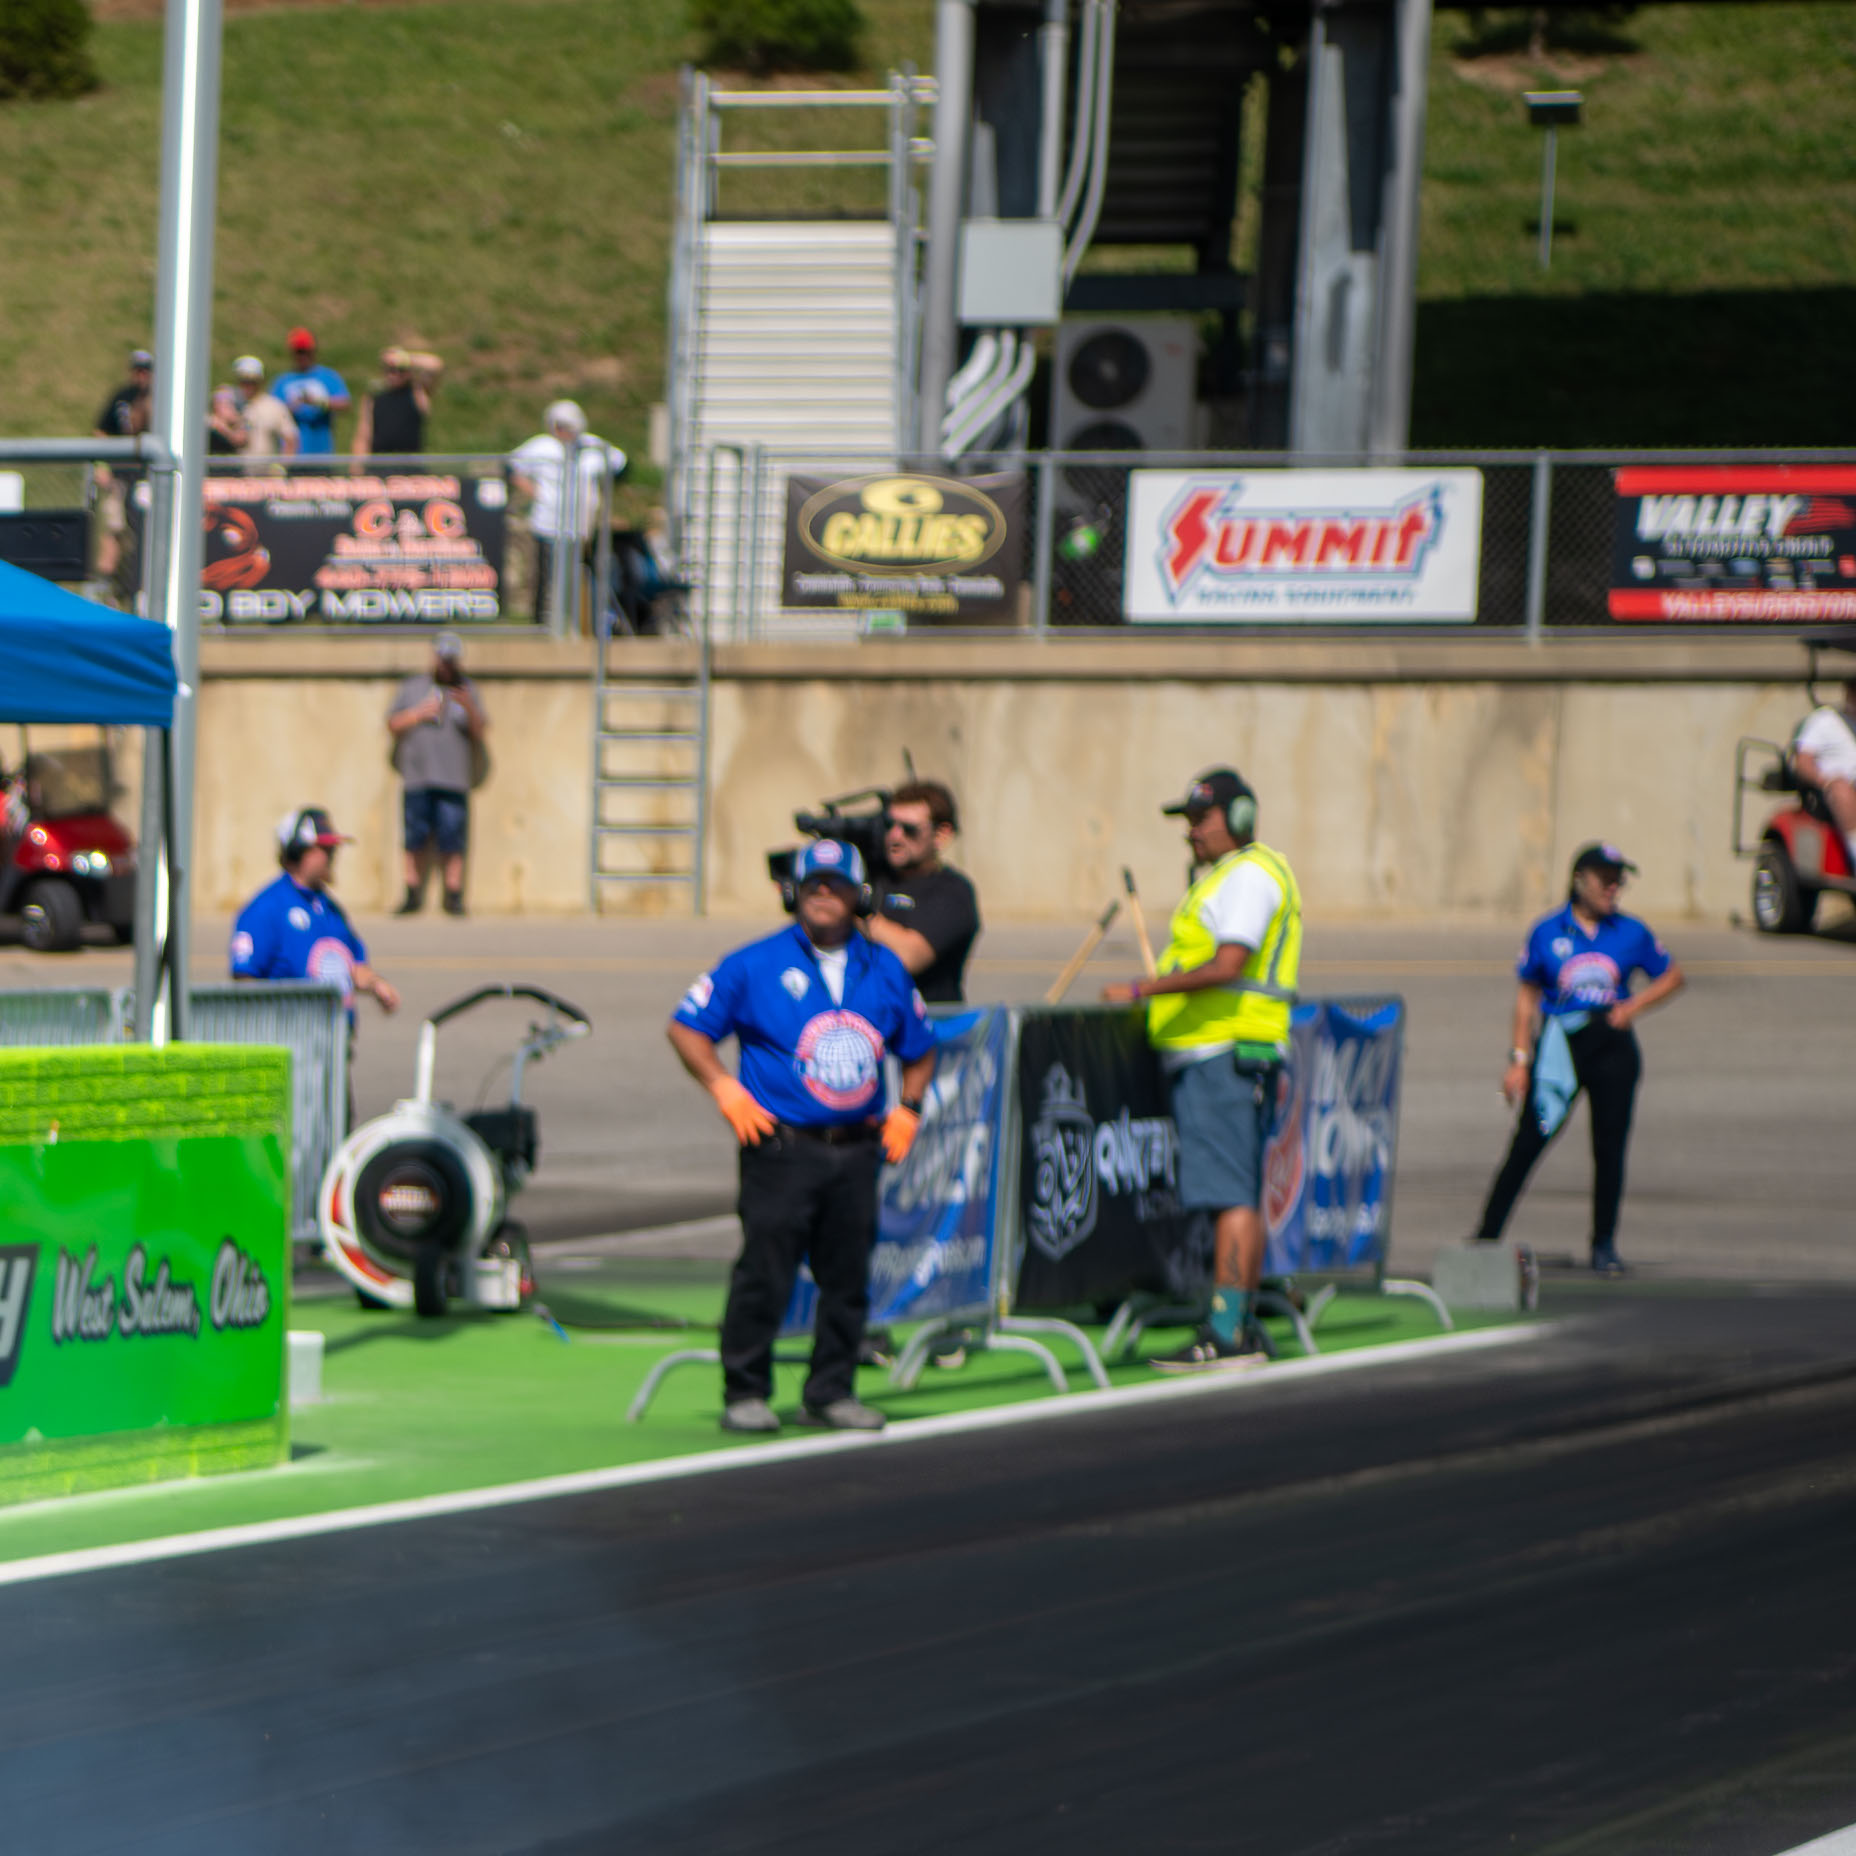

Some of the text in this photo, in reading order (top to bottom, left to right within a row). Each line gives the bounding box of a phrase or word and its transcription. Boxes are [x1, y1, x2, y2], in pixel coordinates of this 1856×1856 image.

[1638, 495, 1802, 540] VALLEY
[228, 589, 315, 621] BOY
[321, 589, 499, 621] MOWERS
[53, 1246, 114, 1343] West
[210, 1237, 269, 1330] Ohio
